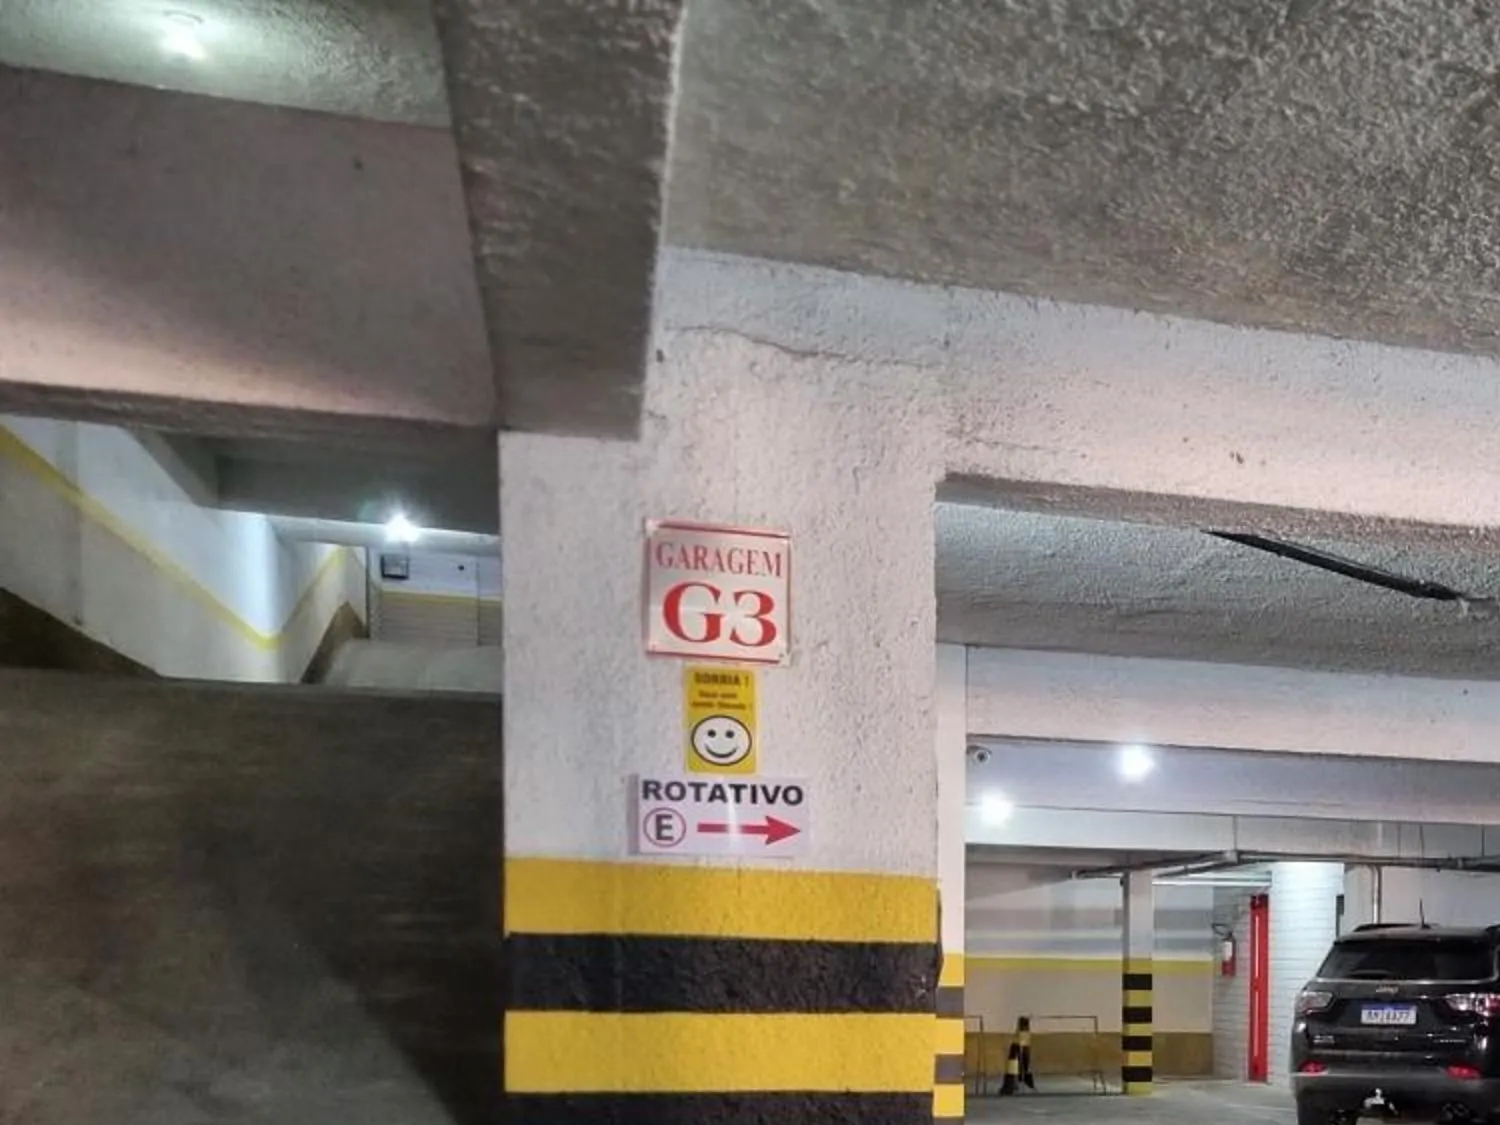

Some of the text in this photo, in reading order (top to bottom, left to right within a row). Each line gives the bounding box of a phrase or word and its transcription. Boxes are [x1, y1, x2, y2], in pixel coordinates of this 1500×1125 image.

[655, 541, 783, 579] GARAGEM
[662, 581, 778, 648] G3
[642, 779, 805, 807] ROTATIVO
[655, 813, 675, 842] E
